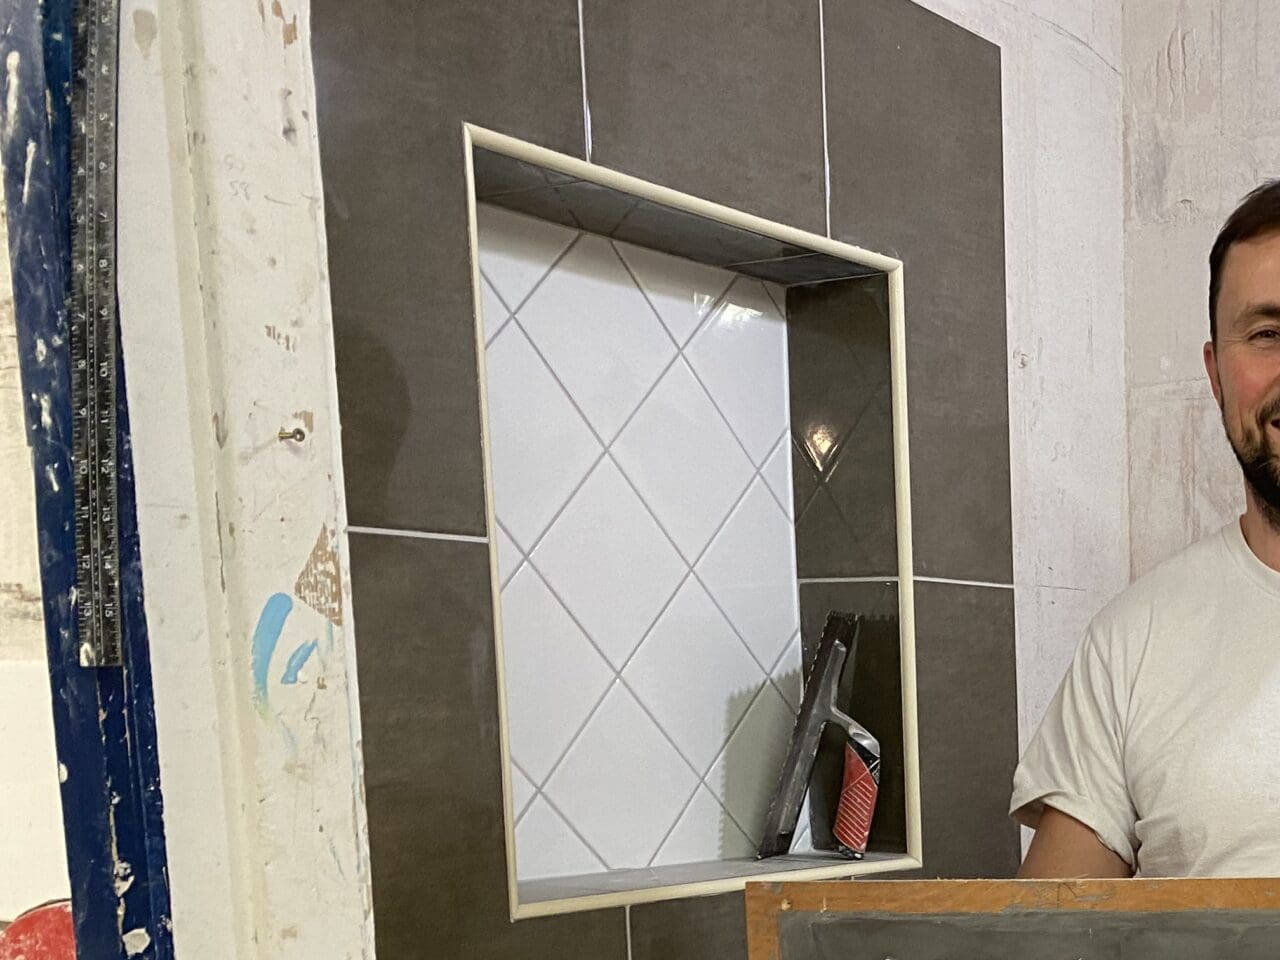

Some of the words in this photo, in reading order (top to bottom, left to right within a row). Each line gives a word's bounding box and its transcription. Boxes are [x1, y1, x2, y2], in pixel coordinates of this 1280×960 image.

[99, 161, 108, 170] 6
[99, 259, 108, 268] 8
[77, 312, 85, 320] 7
[99, 307, 108, 316] 9
[78, 359, 86, 369] 8
[100, 361, 108, 377] 10
[79, 407, 87, 416] 9
[100, 410, 109, 423] 11
[80, 459, 88, 475] 10
[101, 459, 109, 475] 12
[80, 506, 89, 519] 11
[102, 507, 111, 521] 13
[82, 555, 90, 569] 12
[103, 555, 112, 569] 14
[84, 602, 92, 618] 13
[104, 602, 114, 618] 15
